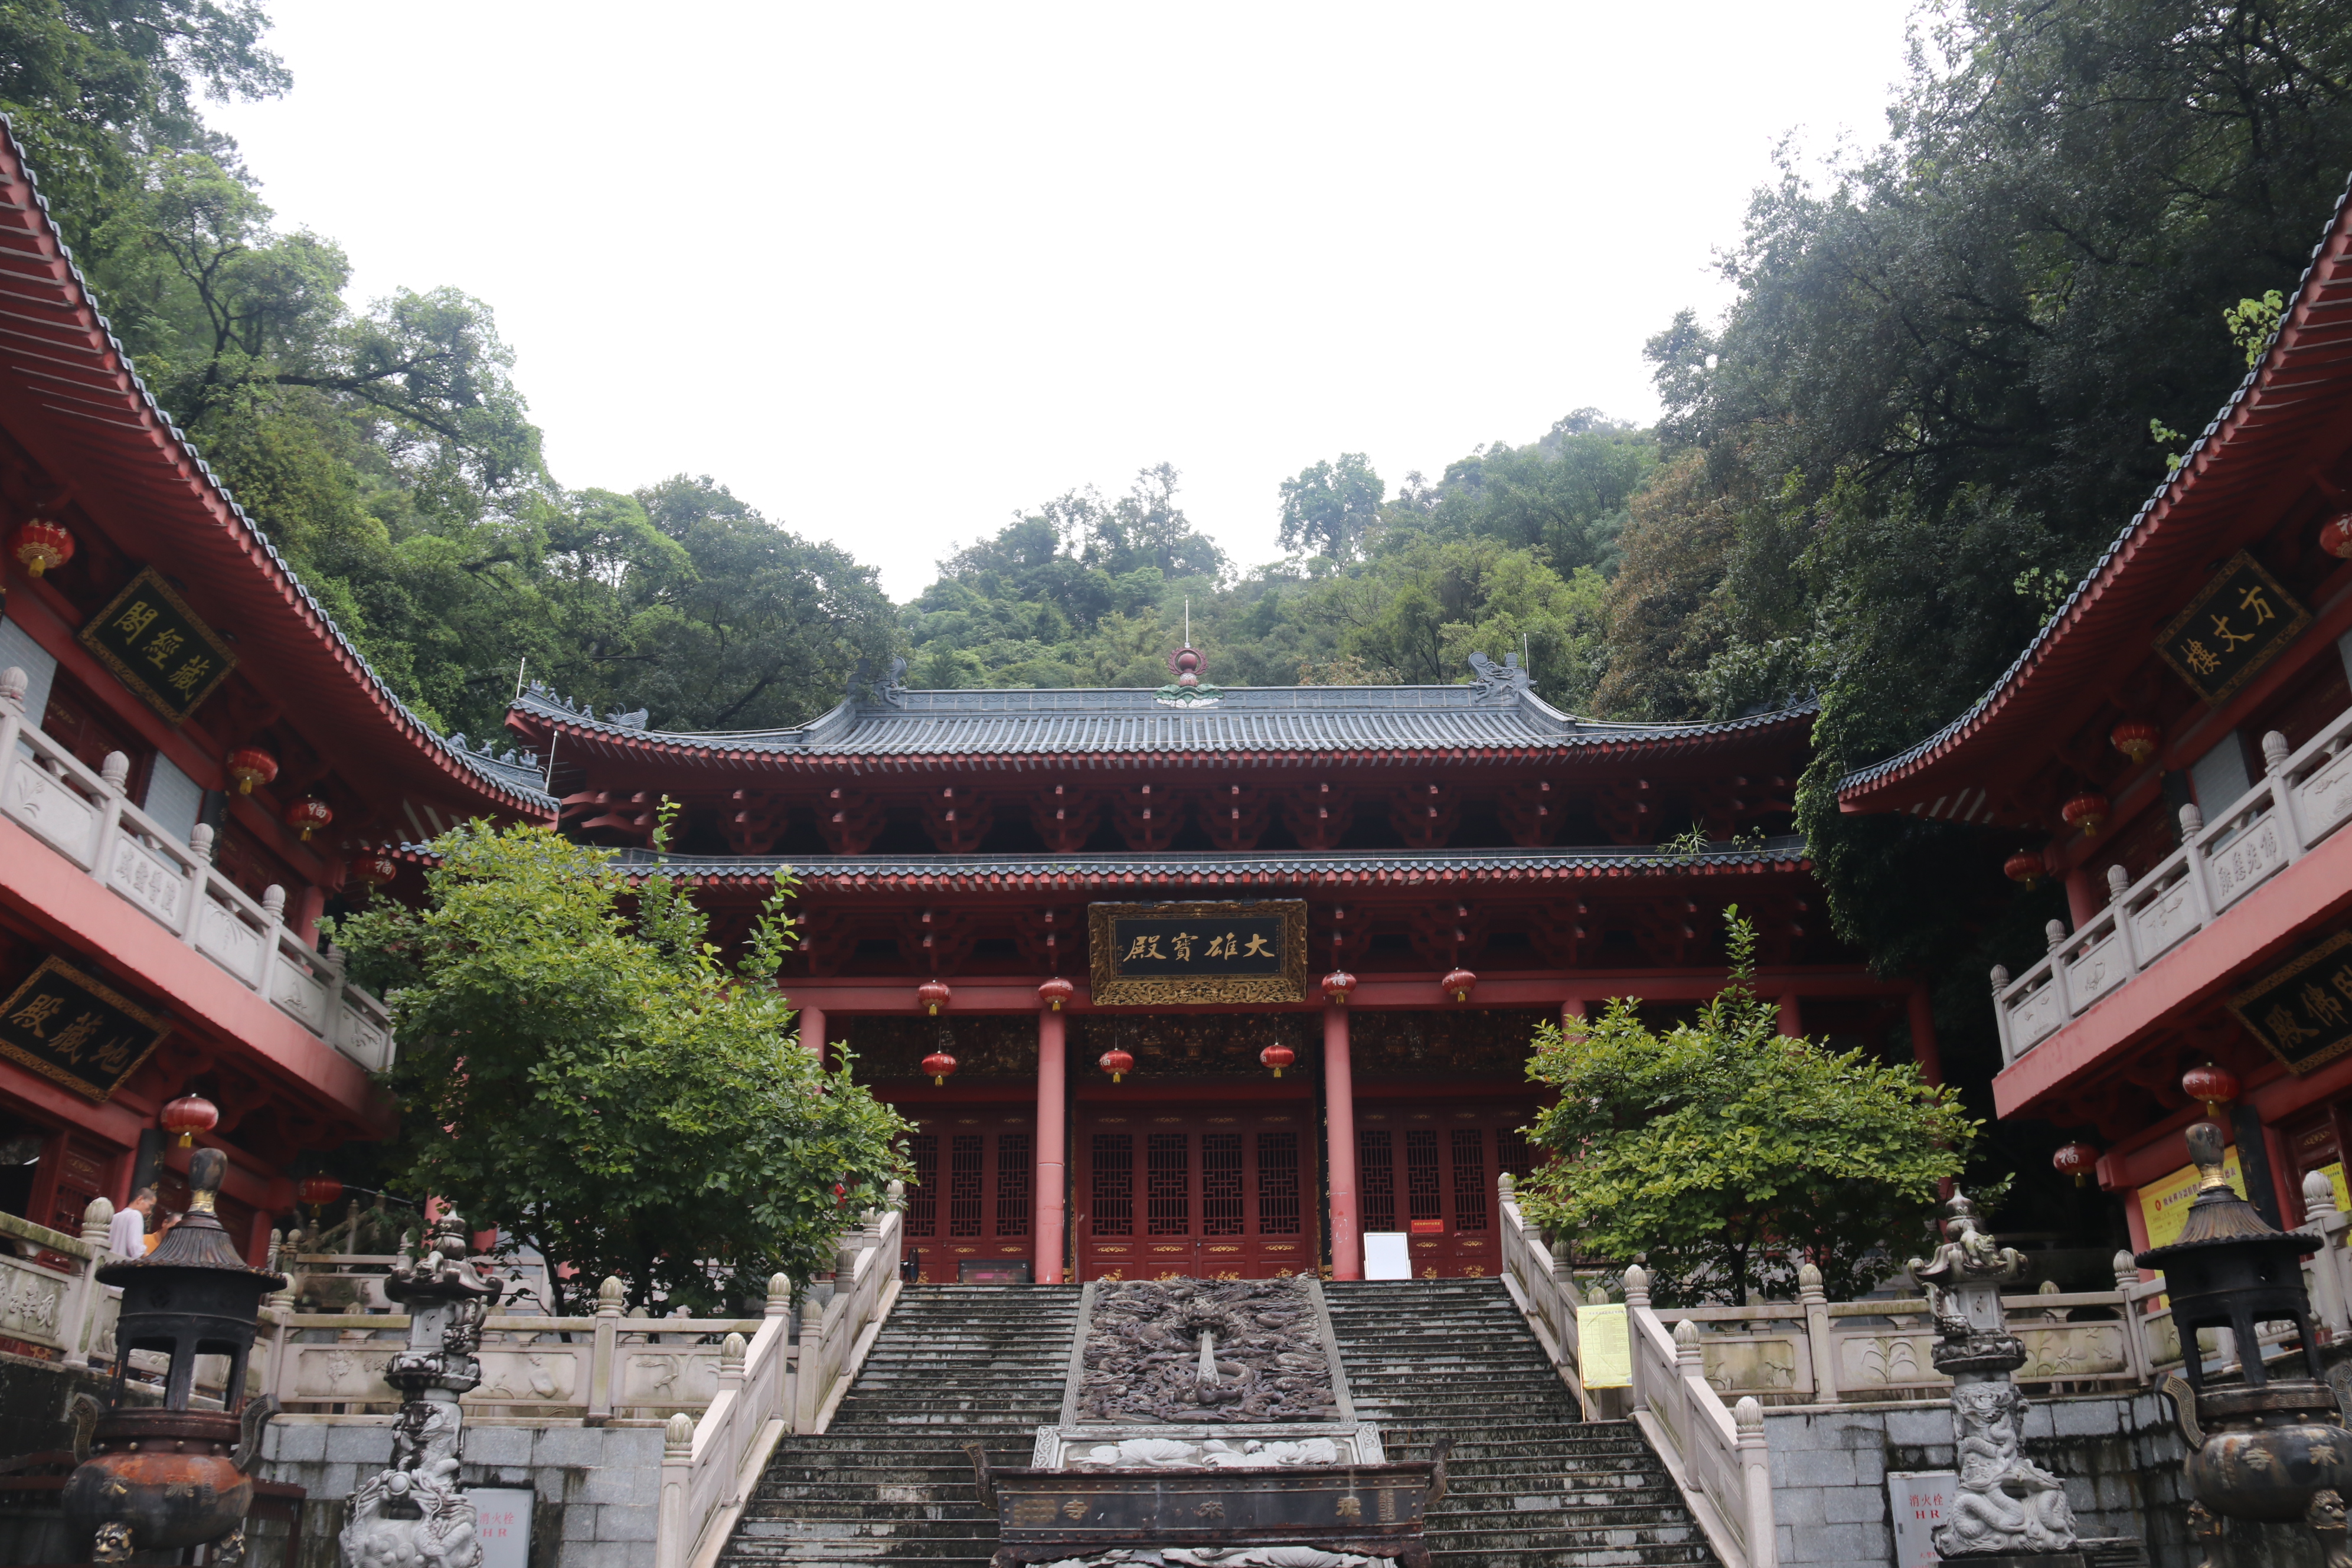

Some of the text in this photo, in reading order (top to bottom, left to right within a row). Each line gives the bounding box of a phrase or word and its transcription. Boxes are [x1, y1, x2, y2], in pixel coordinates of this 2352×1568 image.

[2180, 586, 2275, 674] 方丈樓
[112, 600, 210, 701] 藏經閣
[308, 801, 327, 819] 福
[375, 857, 393, 876] 福
[1123, 932, 1275, 962] 大雄寶殿
[1331, 973, 1347, 986] 福
[9, 994, 133, 1074] 地藏殿
[2059, 1145, 2080, 1167] 福
[1909, 1492, 1944, 1508] 消火栓
[479, 1511, 515, 1525] 消火栓
